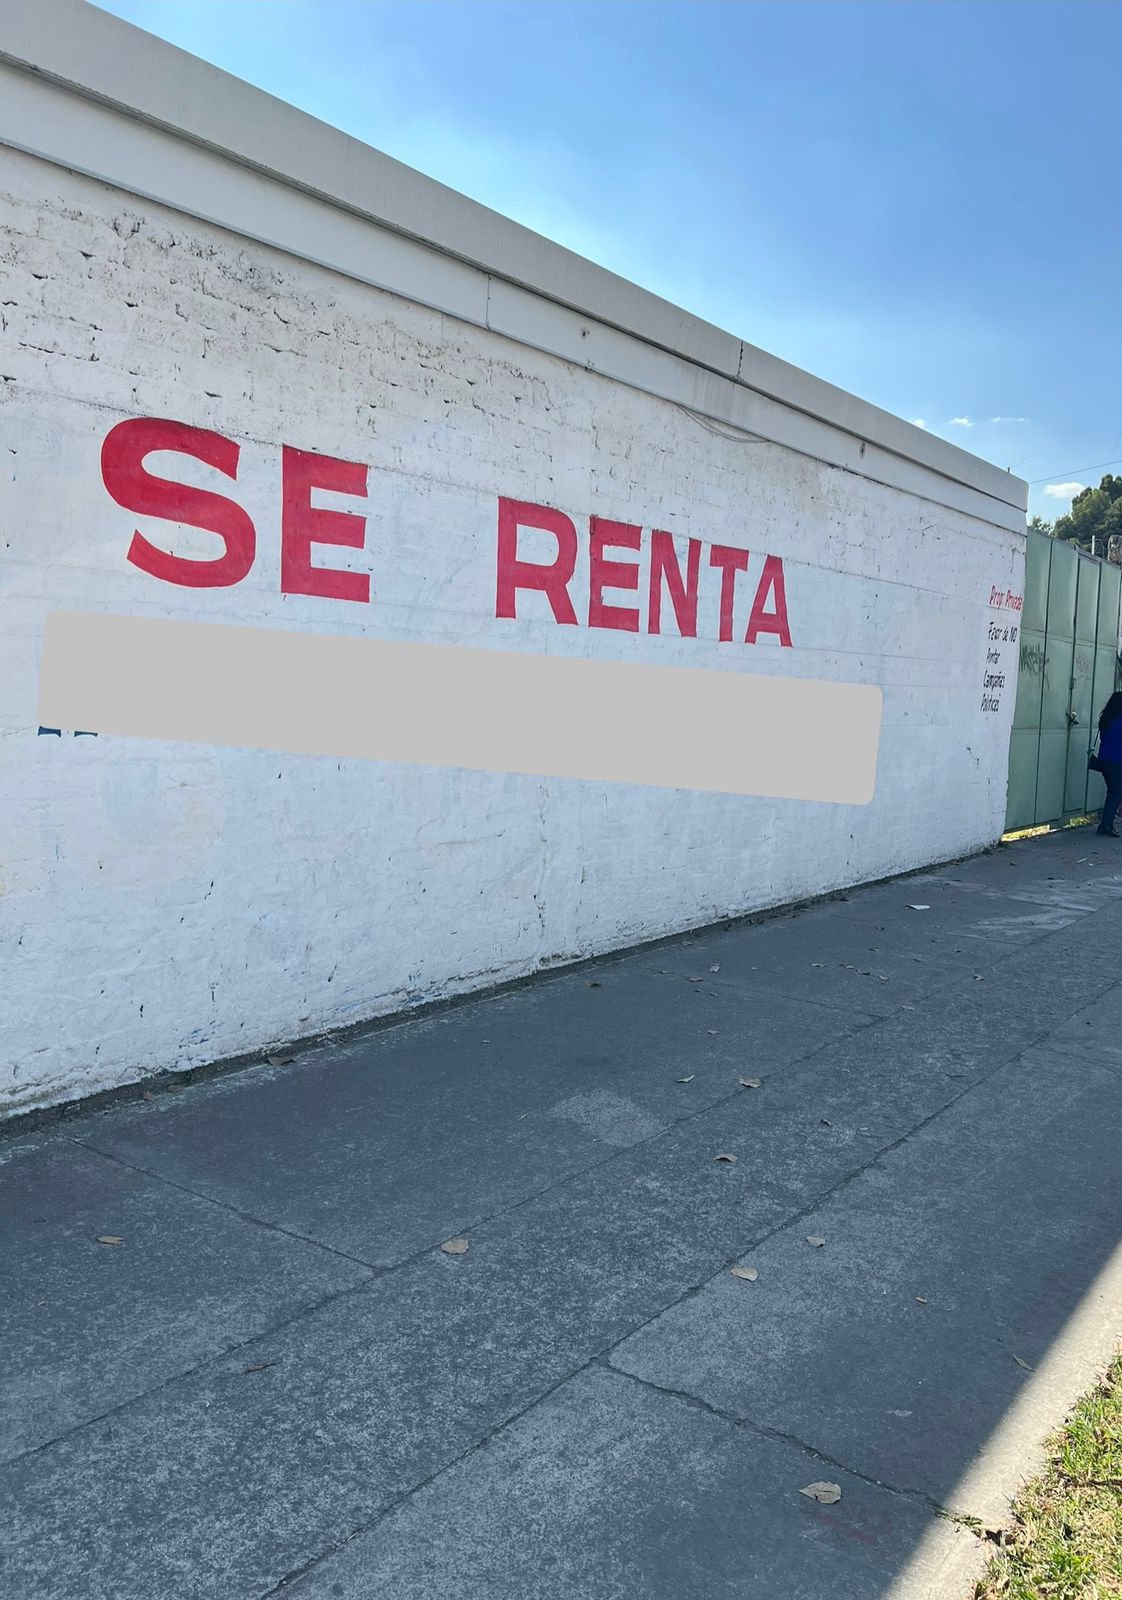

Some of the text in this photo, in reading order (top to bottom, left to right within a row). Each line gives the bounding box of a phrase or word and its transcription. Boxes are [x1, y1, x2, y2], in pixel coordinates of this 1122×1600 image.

[101, 417, 793, 648] SE RENTA
[987, 621, 1018, 643] Favor de NO
